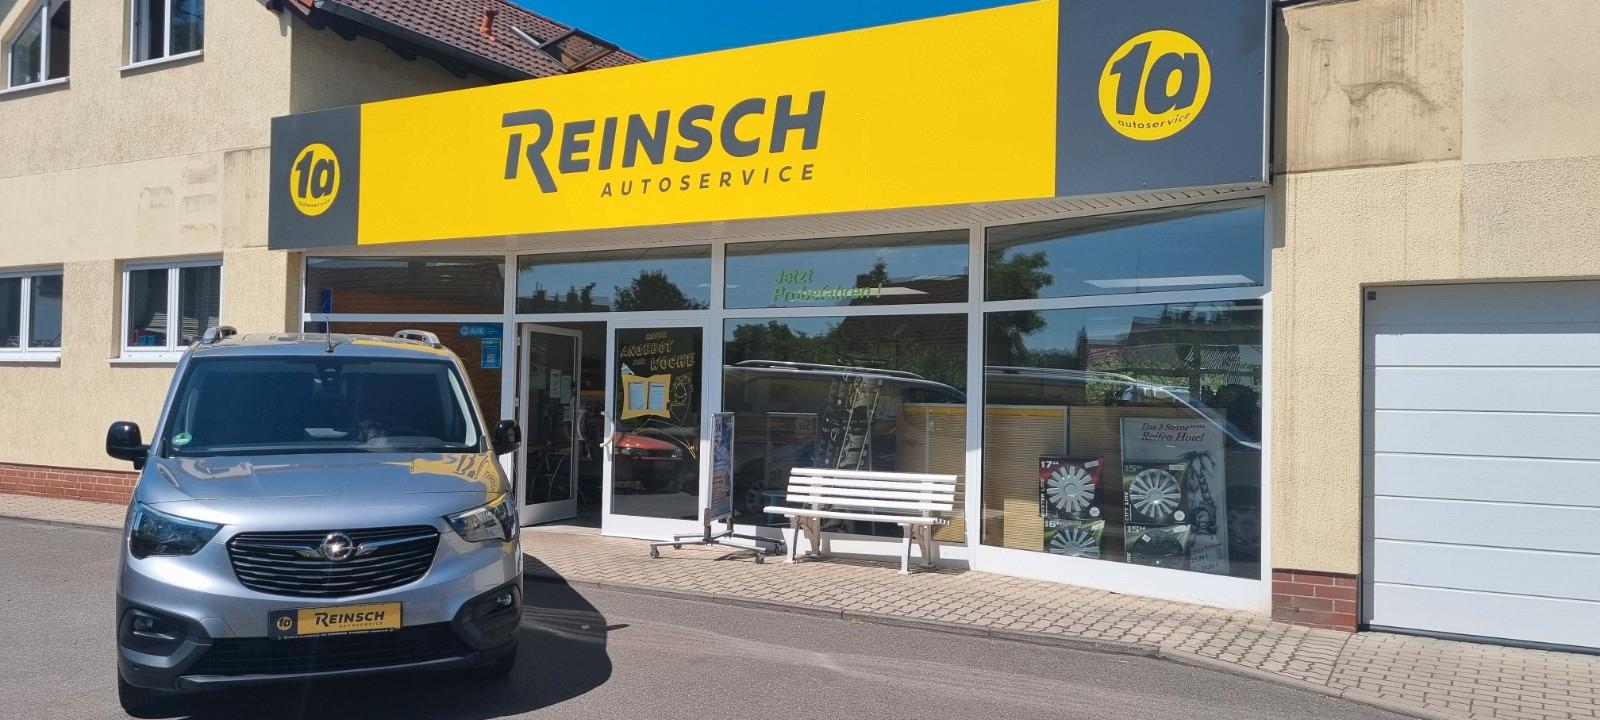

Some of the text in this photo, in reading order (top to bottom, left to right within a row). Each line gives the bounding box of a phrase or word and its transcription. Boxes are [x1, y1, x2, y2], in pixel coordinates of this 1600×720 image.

[1109, 41, 1200, 115] 1a
[1118, 112, 1191, 129] autoservice
[501, 90, 826, 193] REINSCH
[295, 150, 335, 198] 1a
[600, 164, 815, 198] AUTOSERVICE
[775, 268, 814, 284] Jetzt
[620, 341, 675, 358] ANGEBOT
[650, 352, 696, 371] WOCHE
[1141, 431, 1206, 442] Reifen Hotel
[315, 611, 385, 627] REINSCH
